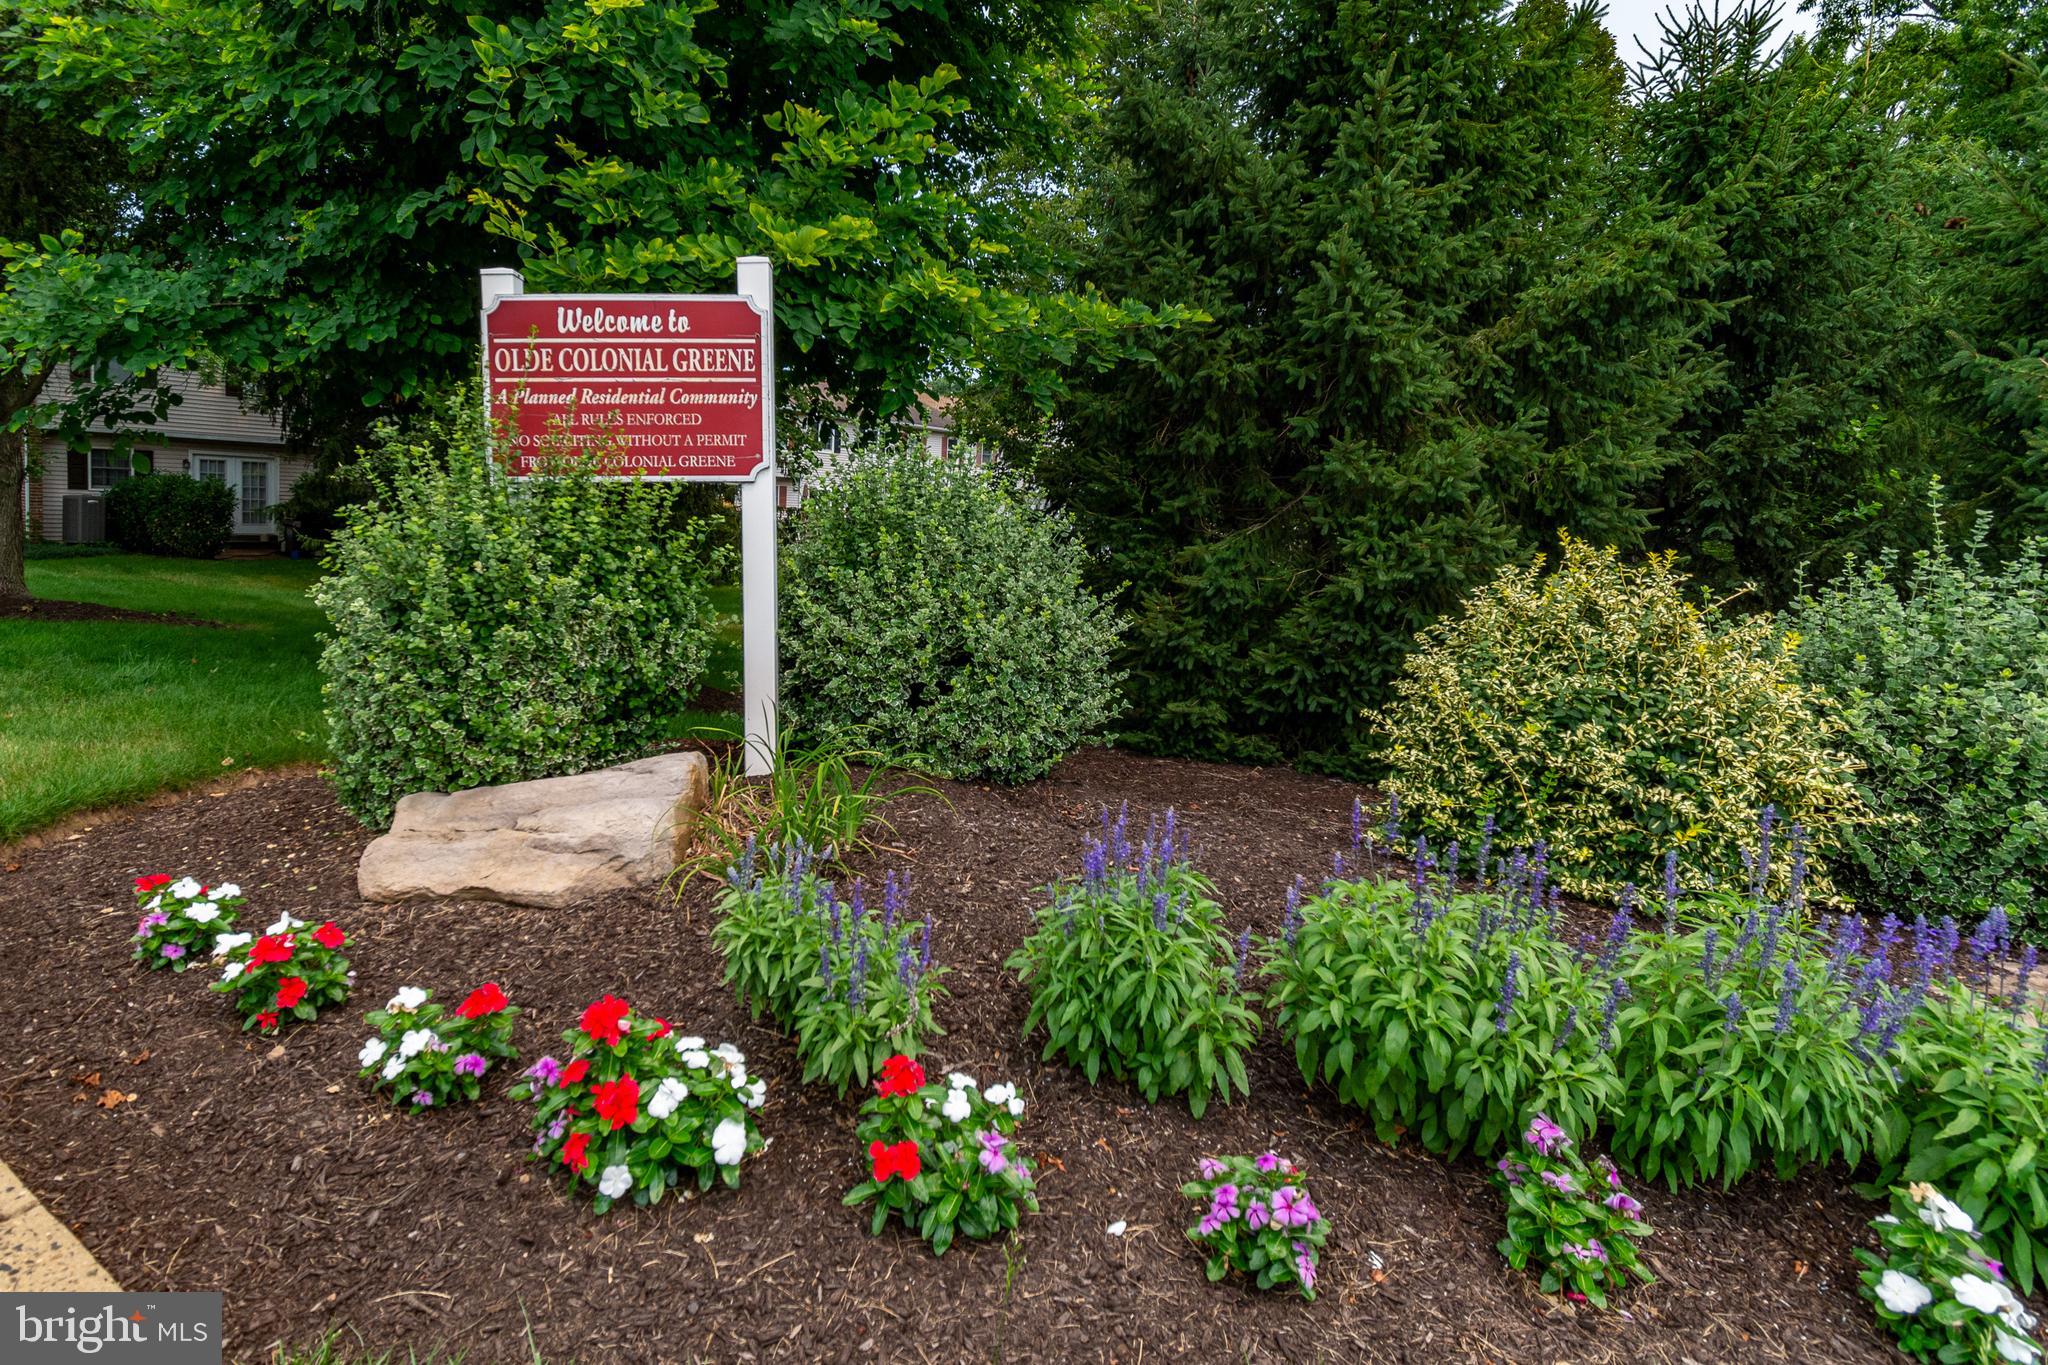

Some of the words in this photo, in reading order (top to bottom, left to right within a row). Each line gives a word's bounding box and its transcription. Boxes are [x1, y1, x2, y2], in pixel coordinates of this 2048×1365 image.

[557, 306, 663, 334] Welcome
[668, 308, 691, 333] to
[494, 348, 553, 373] OLDE
[558, 348, 668, 373] COLONIAL
[672, 347, 756, 372] GREENE
[495, 389, 508, 405] A
[514, 387, 577, 405] Planned
[580, 388, 665, 405] Residential
[669, 388, 758, 409] Community
[626, 413, 702, 426] ENFORCED
[615, 434, 682, 447] WITHOUT
[684, 434, 694, 447] A
[696, 434, 747, 447] PERMIT
[521, 456, 558, 468] FRO
[679, 455, 736, 467] GREENE
